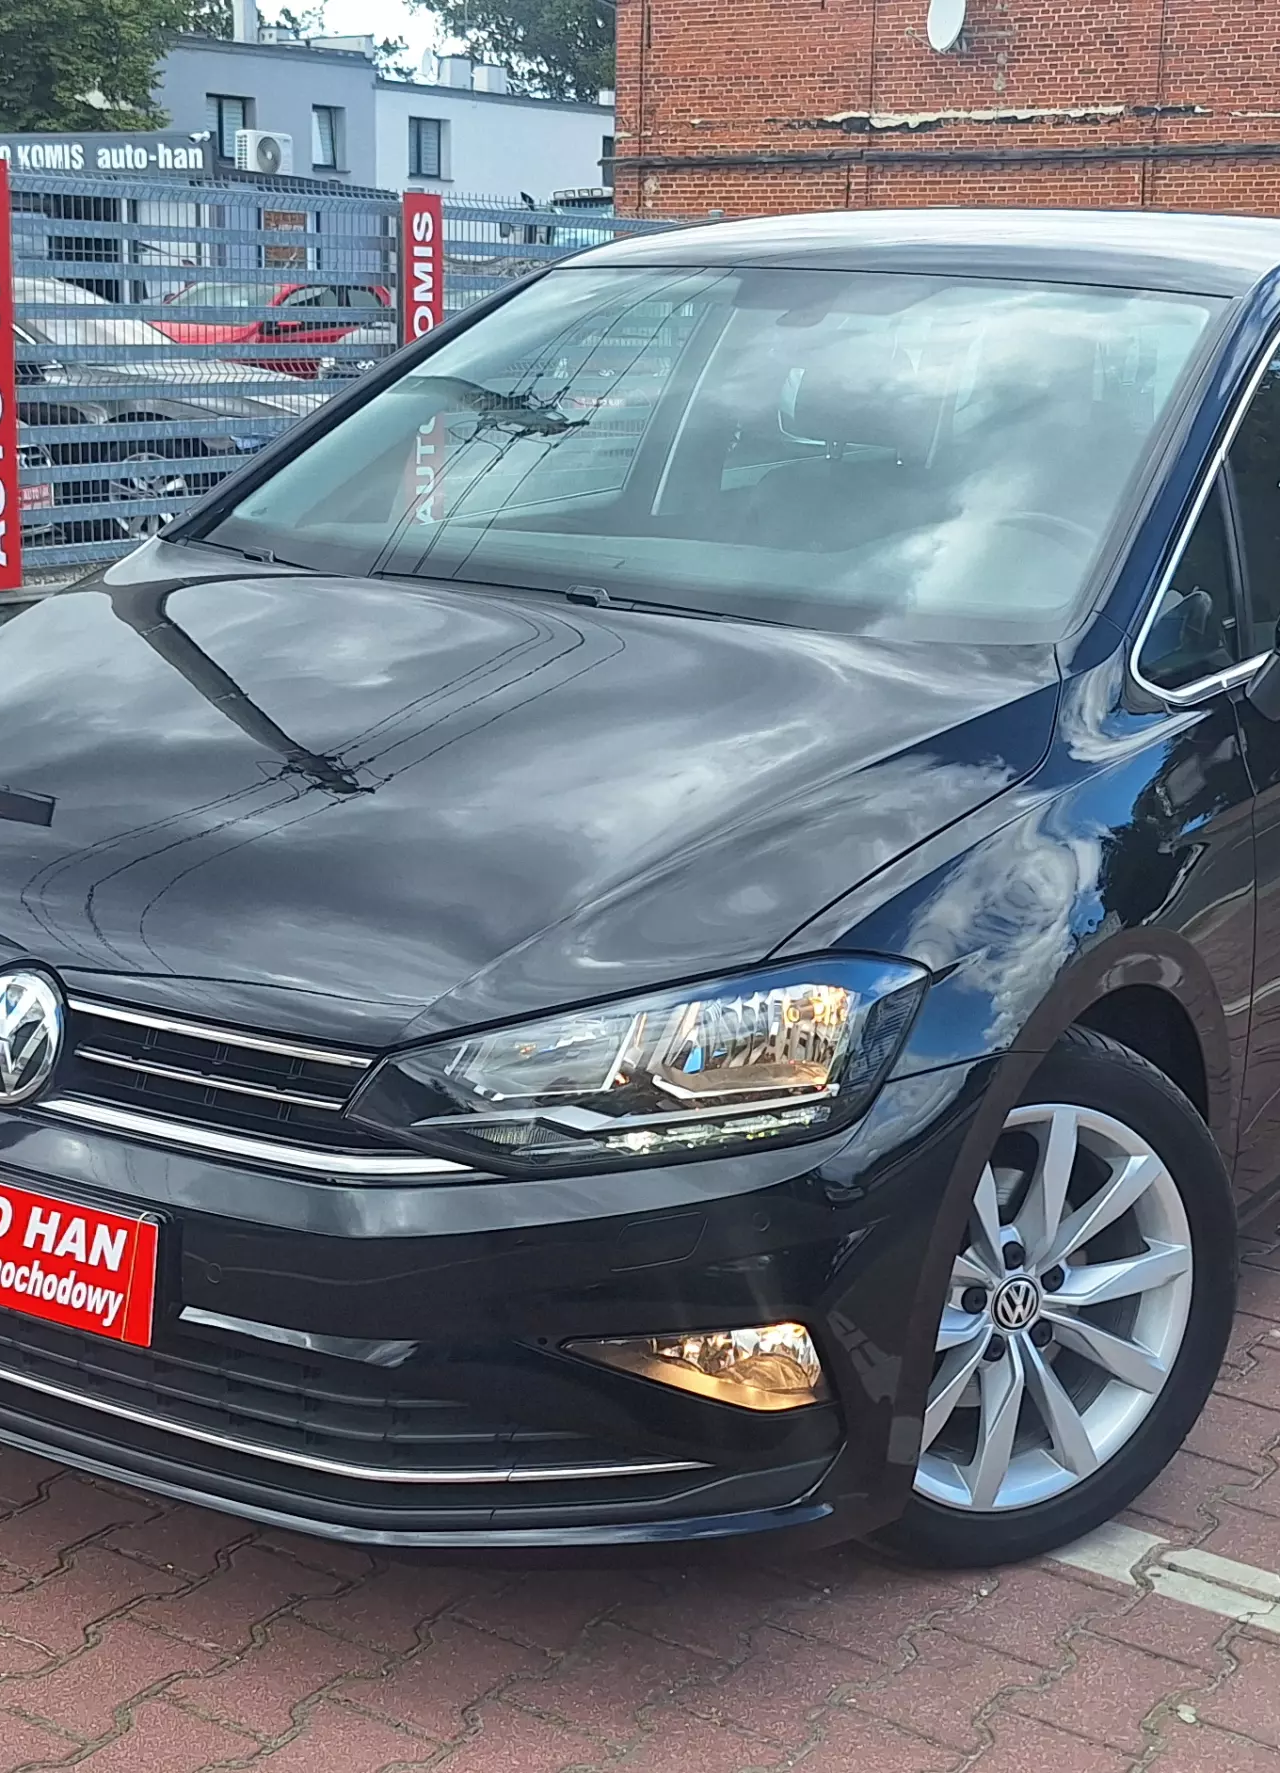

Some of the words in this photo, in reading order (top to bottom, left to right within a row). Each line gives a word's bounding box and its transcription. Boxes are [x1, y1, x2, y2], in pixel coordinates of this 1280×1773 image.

[17, 143, 84, 170] KOMIS
[97, 143, 204, 169] auto-han
[412, 211, 434, 339] OMIS
[22, 1205, 128, 1273] HAN
